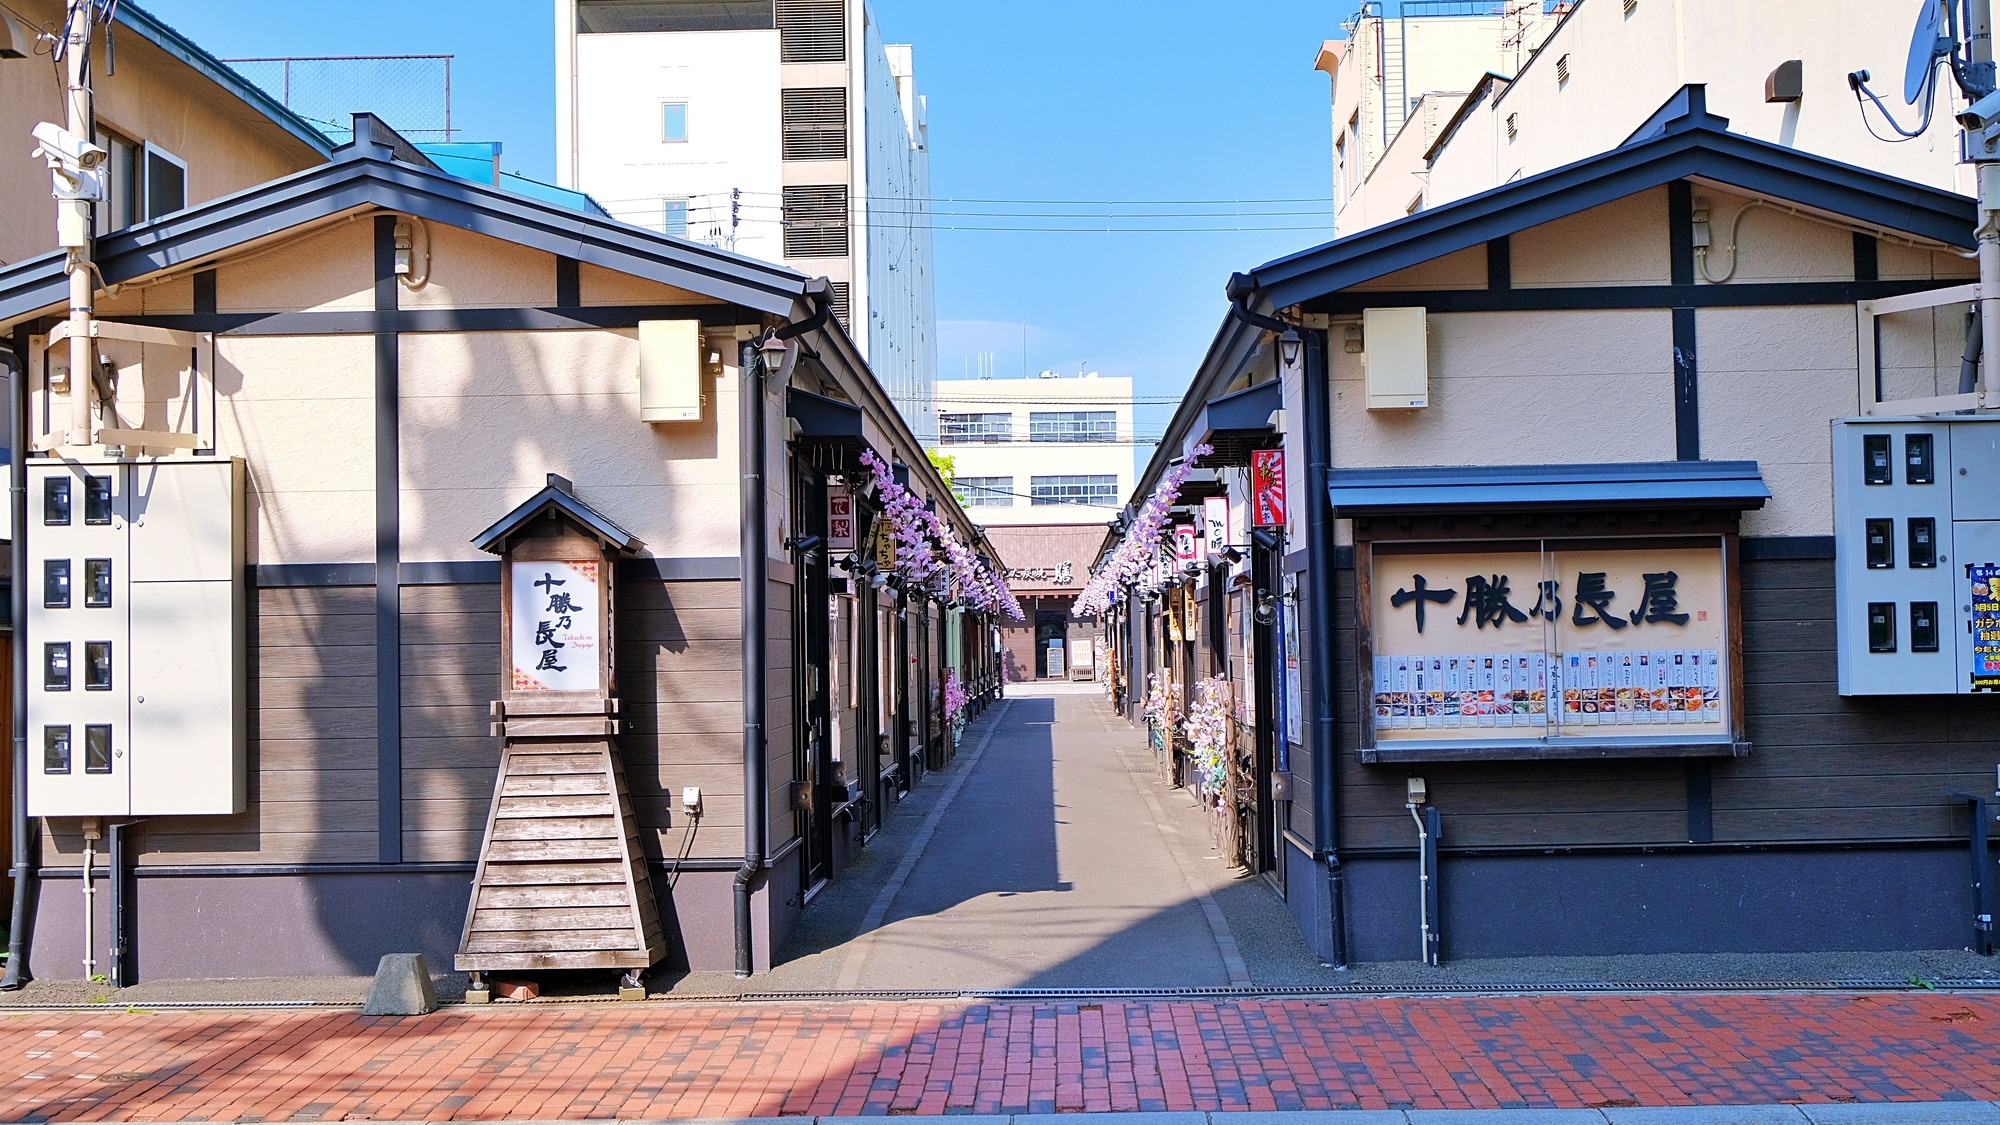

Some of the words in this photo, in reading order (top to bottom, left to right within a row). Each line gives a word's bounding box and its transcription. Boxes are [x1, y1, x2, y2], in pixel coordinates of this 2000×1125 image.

[879, 533, 892, 567] ちゃちゃ
[534, 573, 583, 672] 十勝乃長屋
[1390, 570, 1690, 634] 十勝乃長屋
